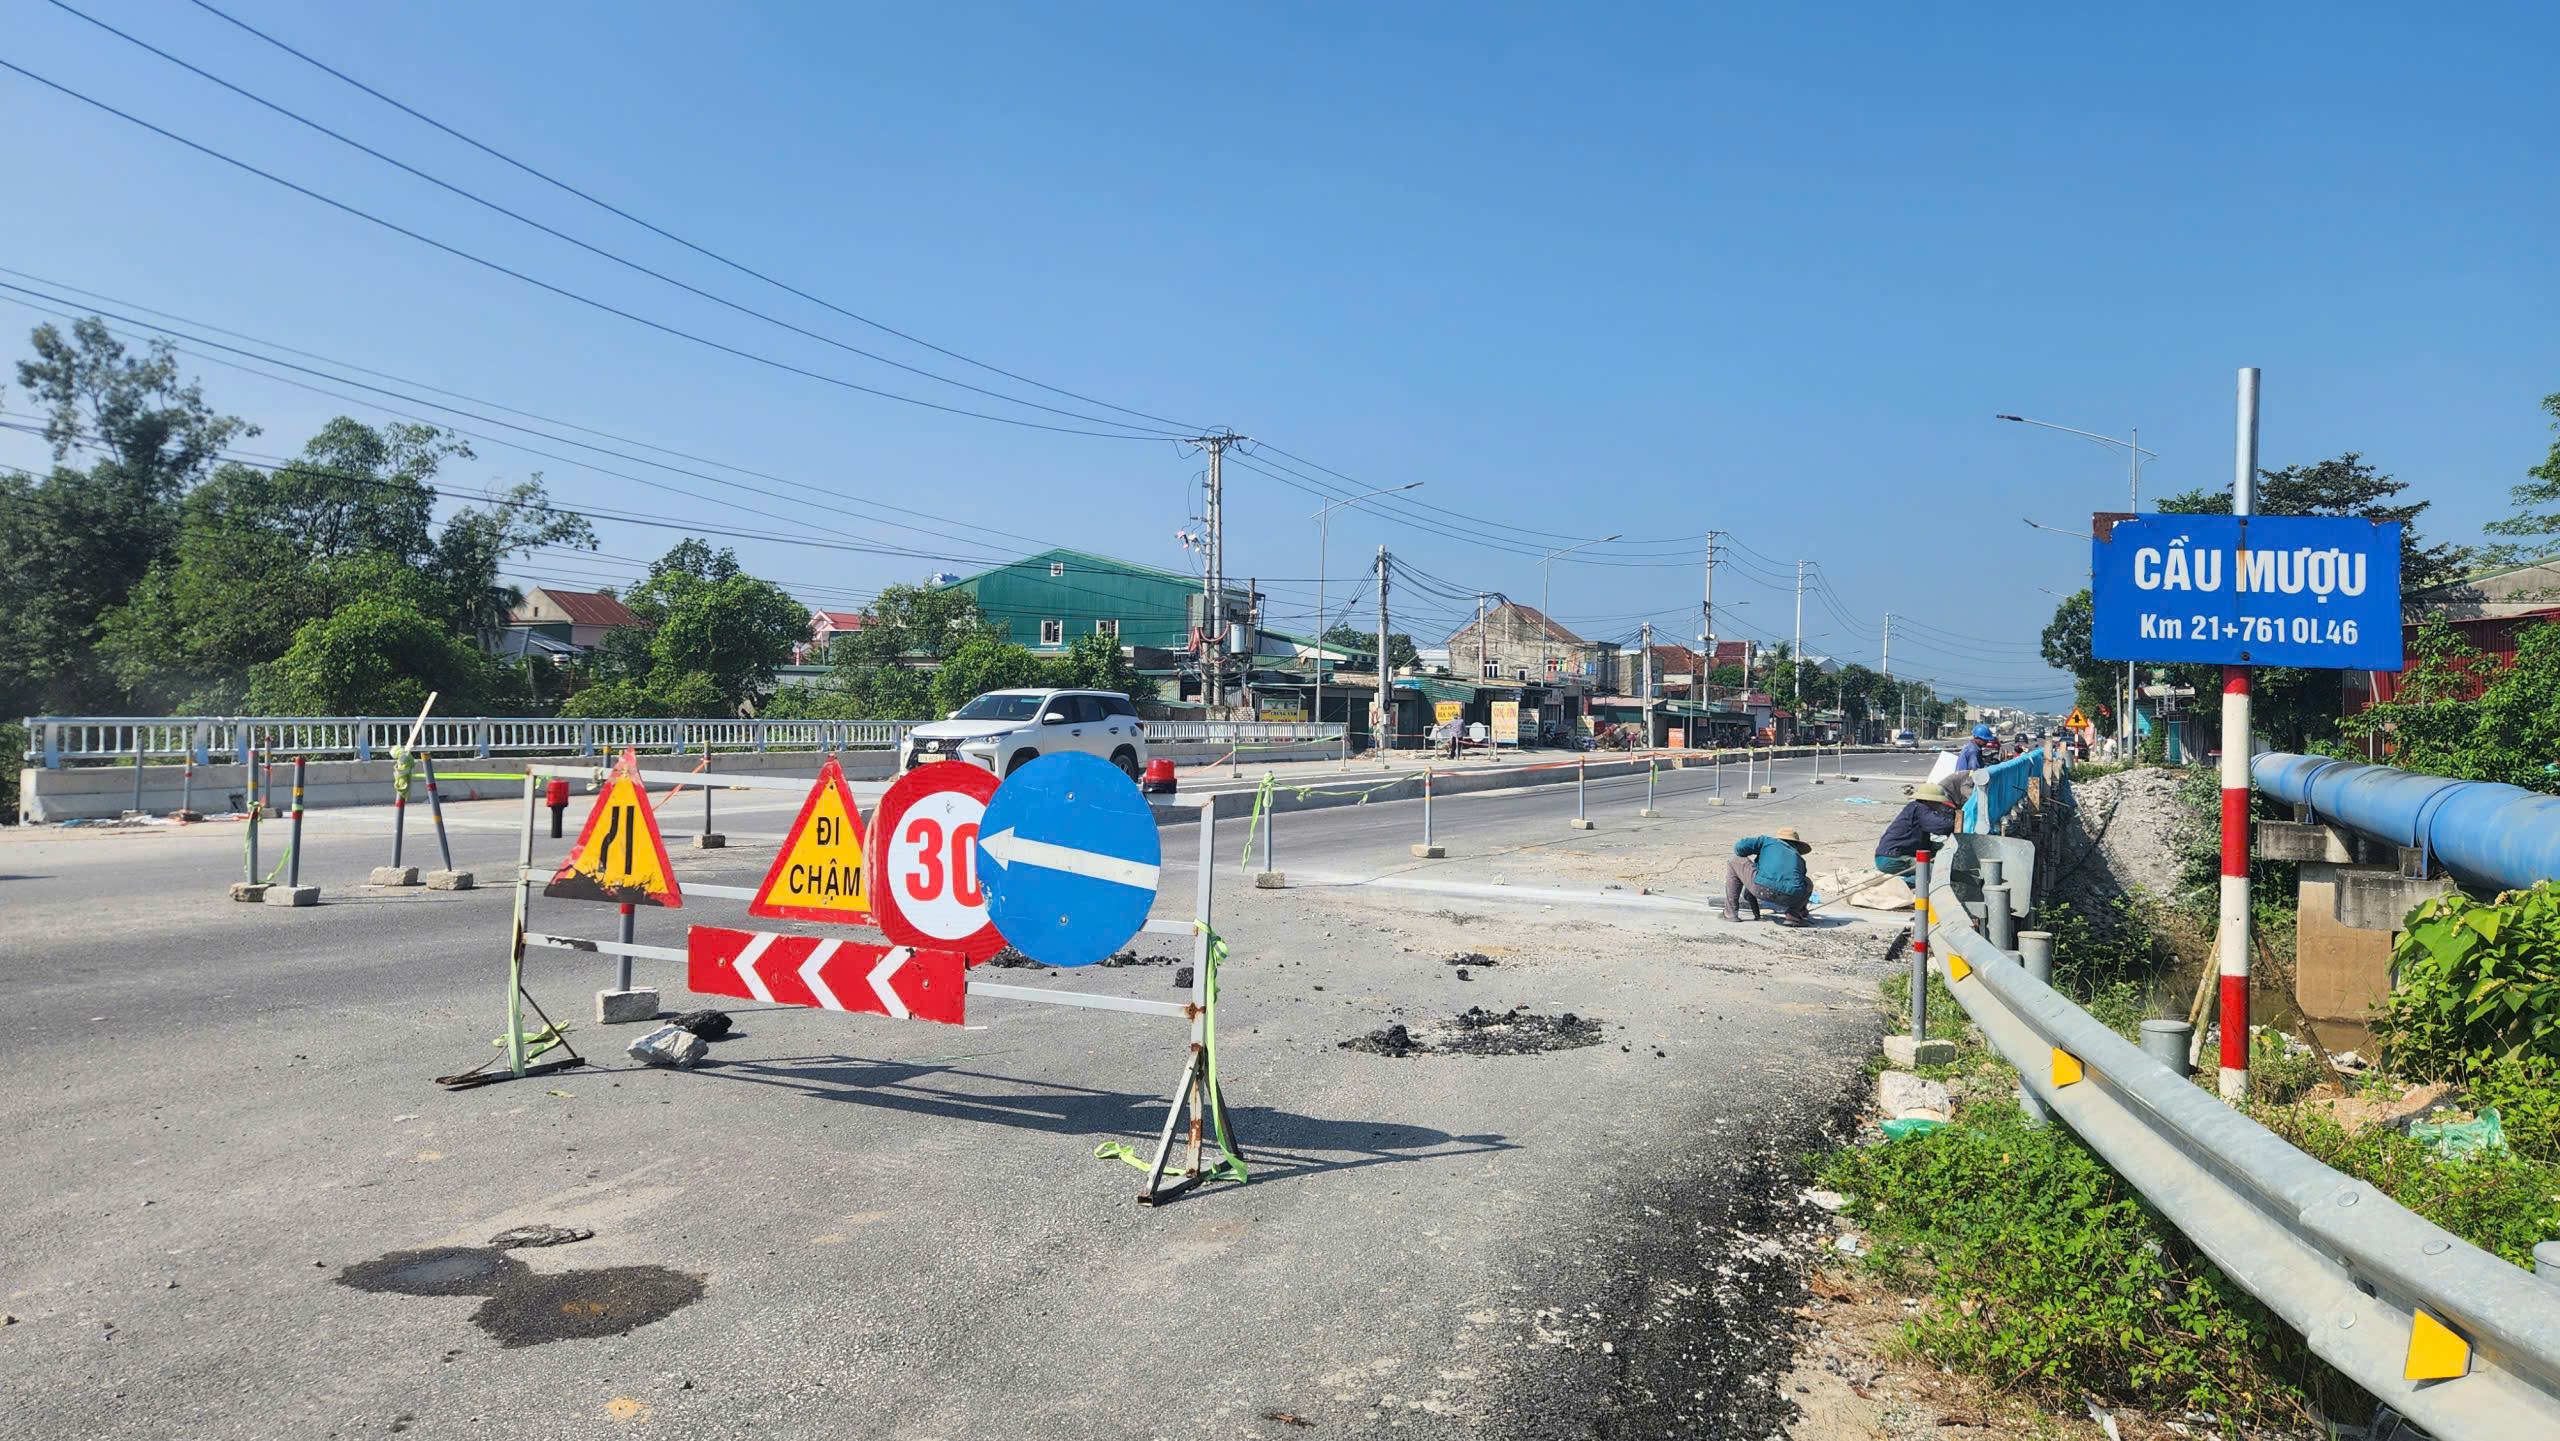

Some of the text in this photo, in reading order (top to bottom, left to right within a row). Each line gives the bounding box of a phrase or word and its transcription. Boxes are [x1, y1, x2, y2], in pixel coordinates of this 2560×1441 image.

[2134, 535, 2367, 604] CẦU MƯỢU
[2140, 613, 2182, 639] Km
[2191, 615, 2285, 643] 21+761
[816, 816, 840, 846] ĐI
[789, 858, 861, 901] CHẬM
[905, 817, 985, 908] 30
